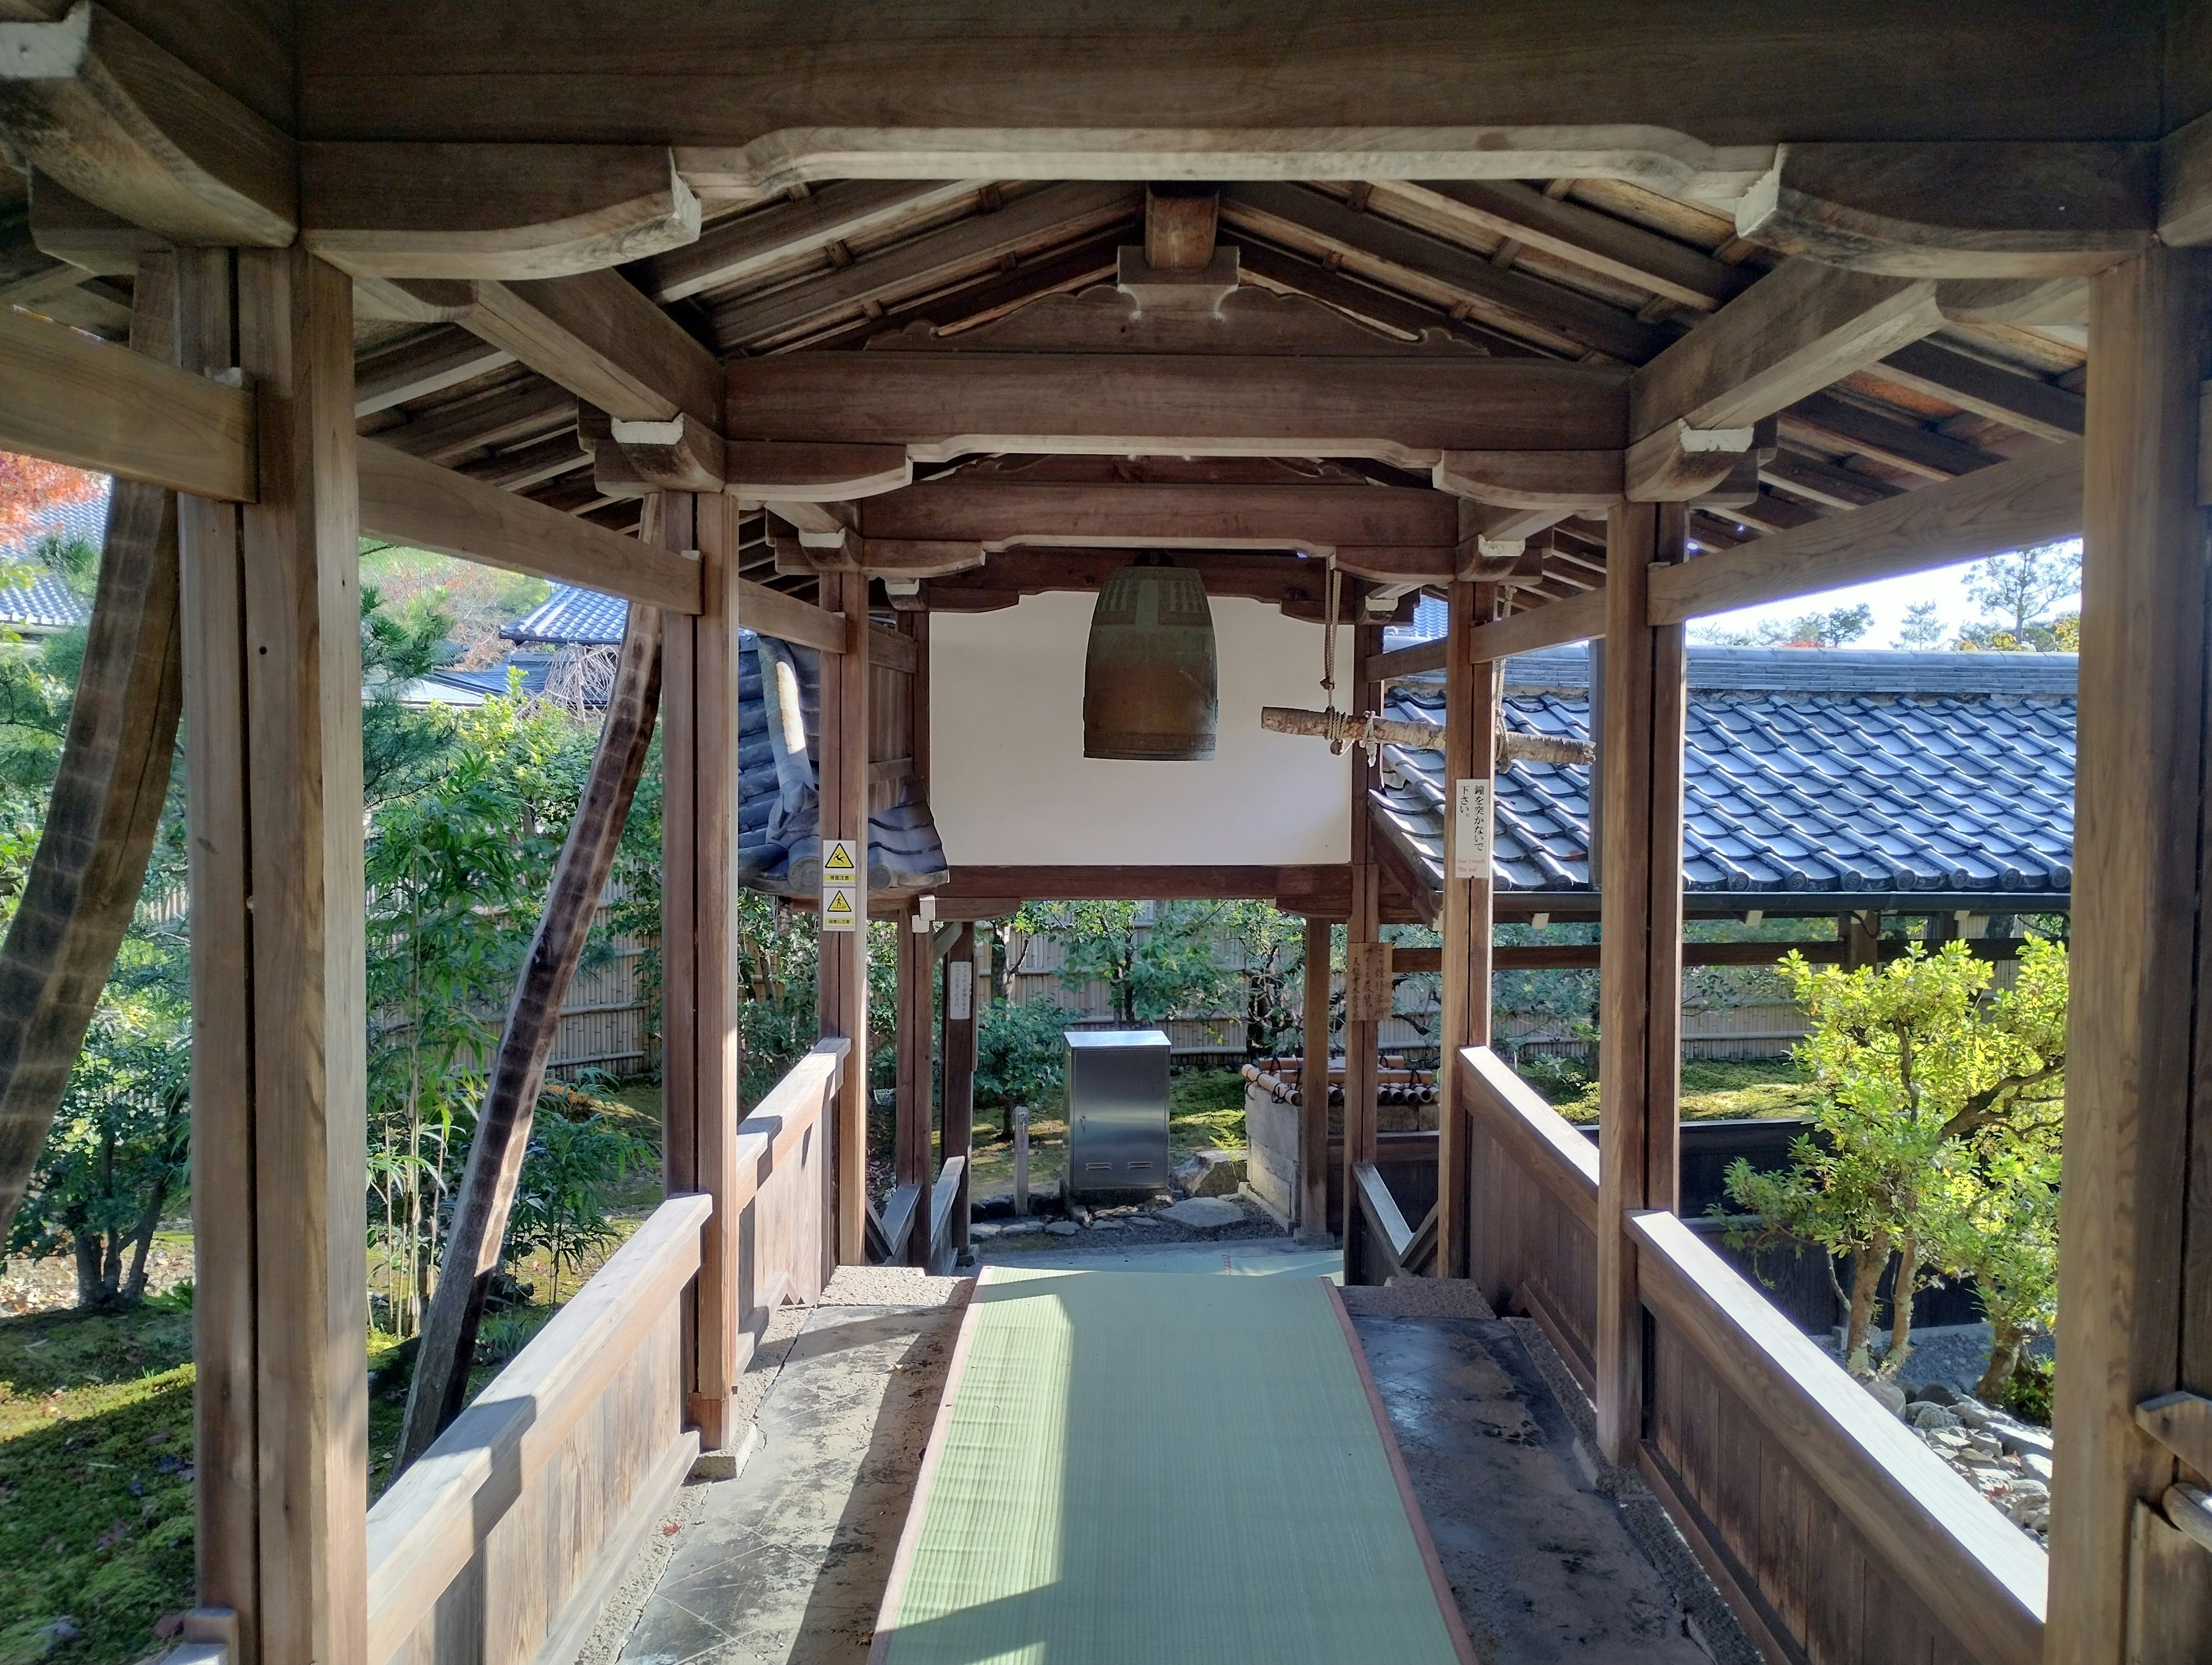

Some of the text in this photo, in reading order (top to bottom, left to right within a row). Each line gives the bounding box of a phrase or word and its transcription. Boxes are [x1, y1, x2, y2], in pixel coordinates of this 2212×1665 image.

[1460, 785, 1470, 818] 下さい。
[1474, 785, 1484, 851] 鐘を突かないで
